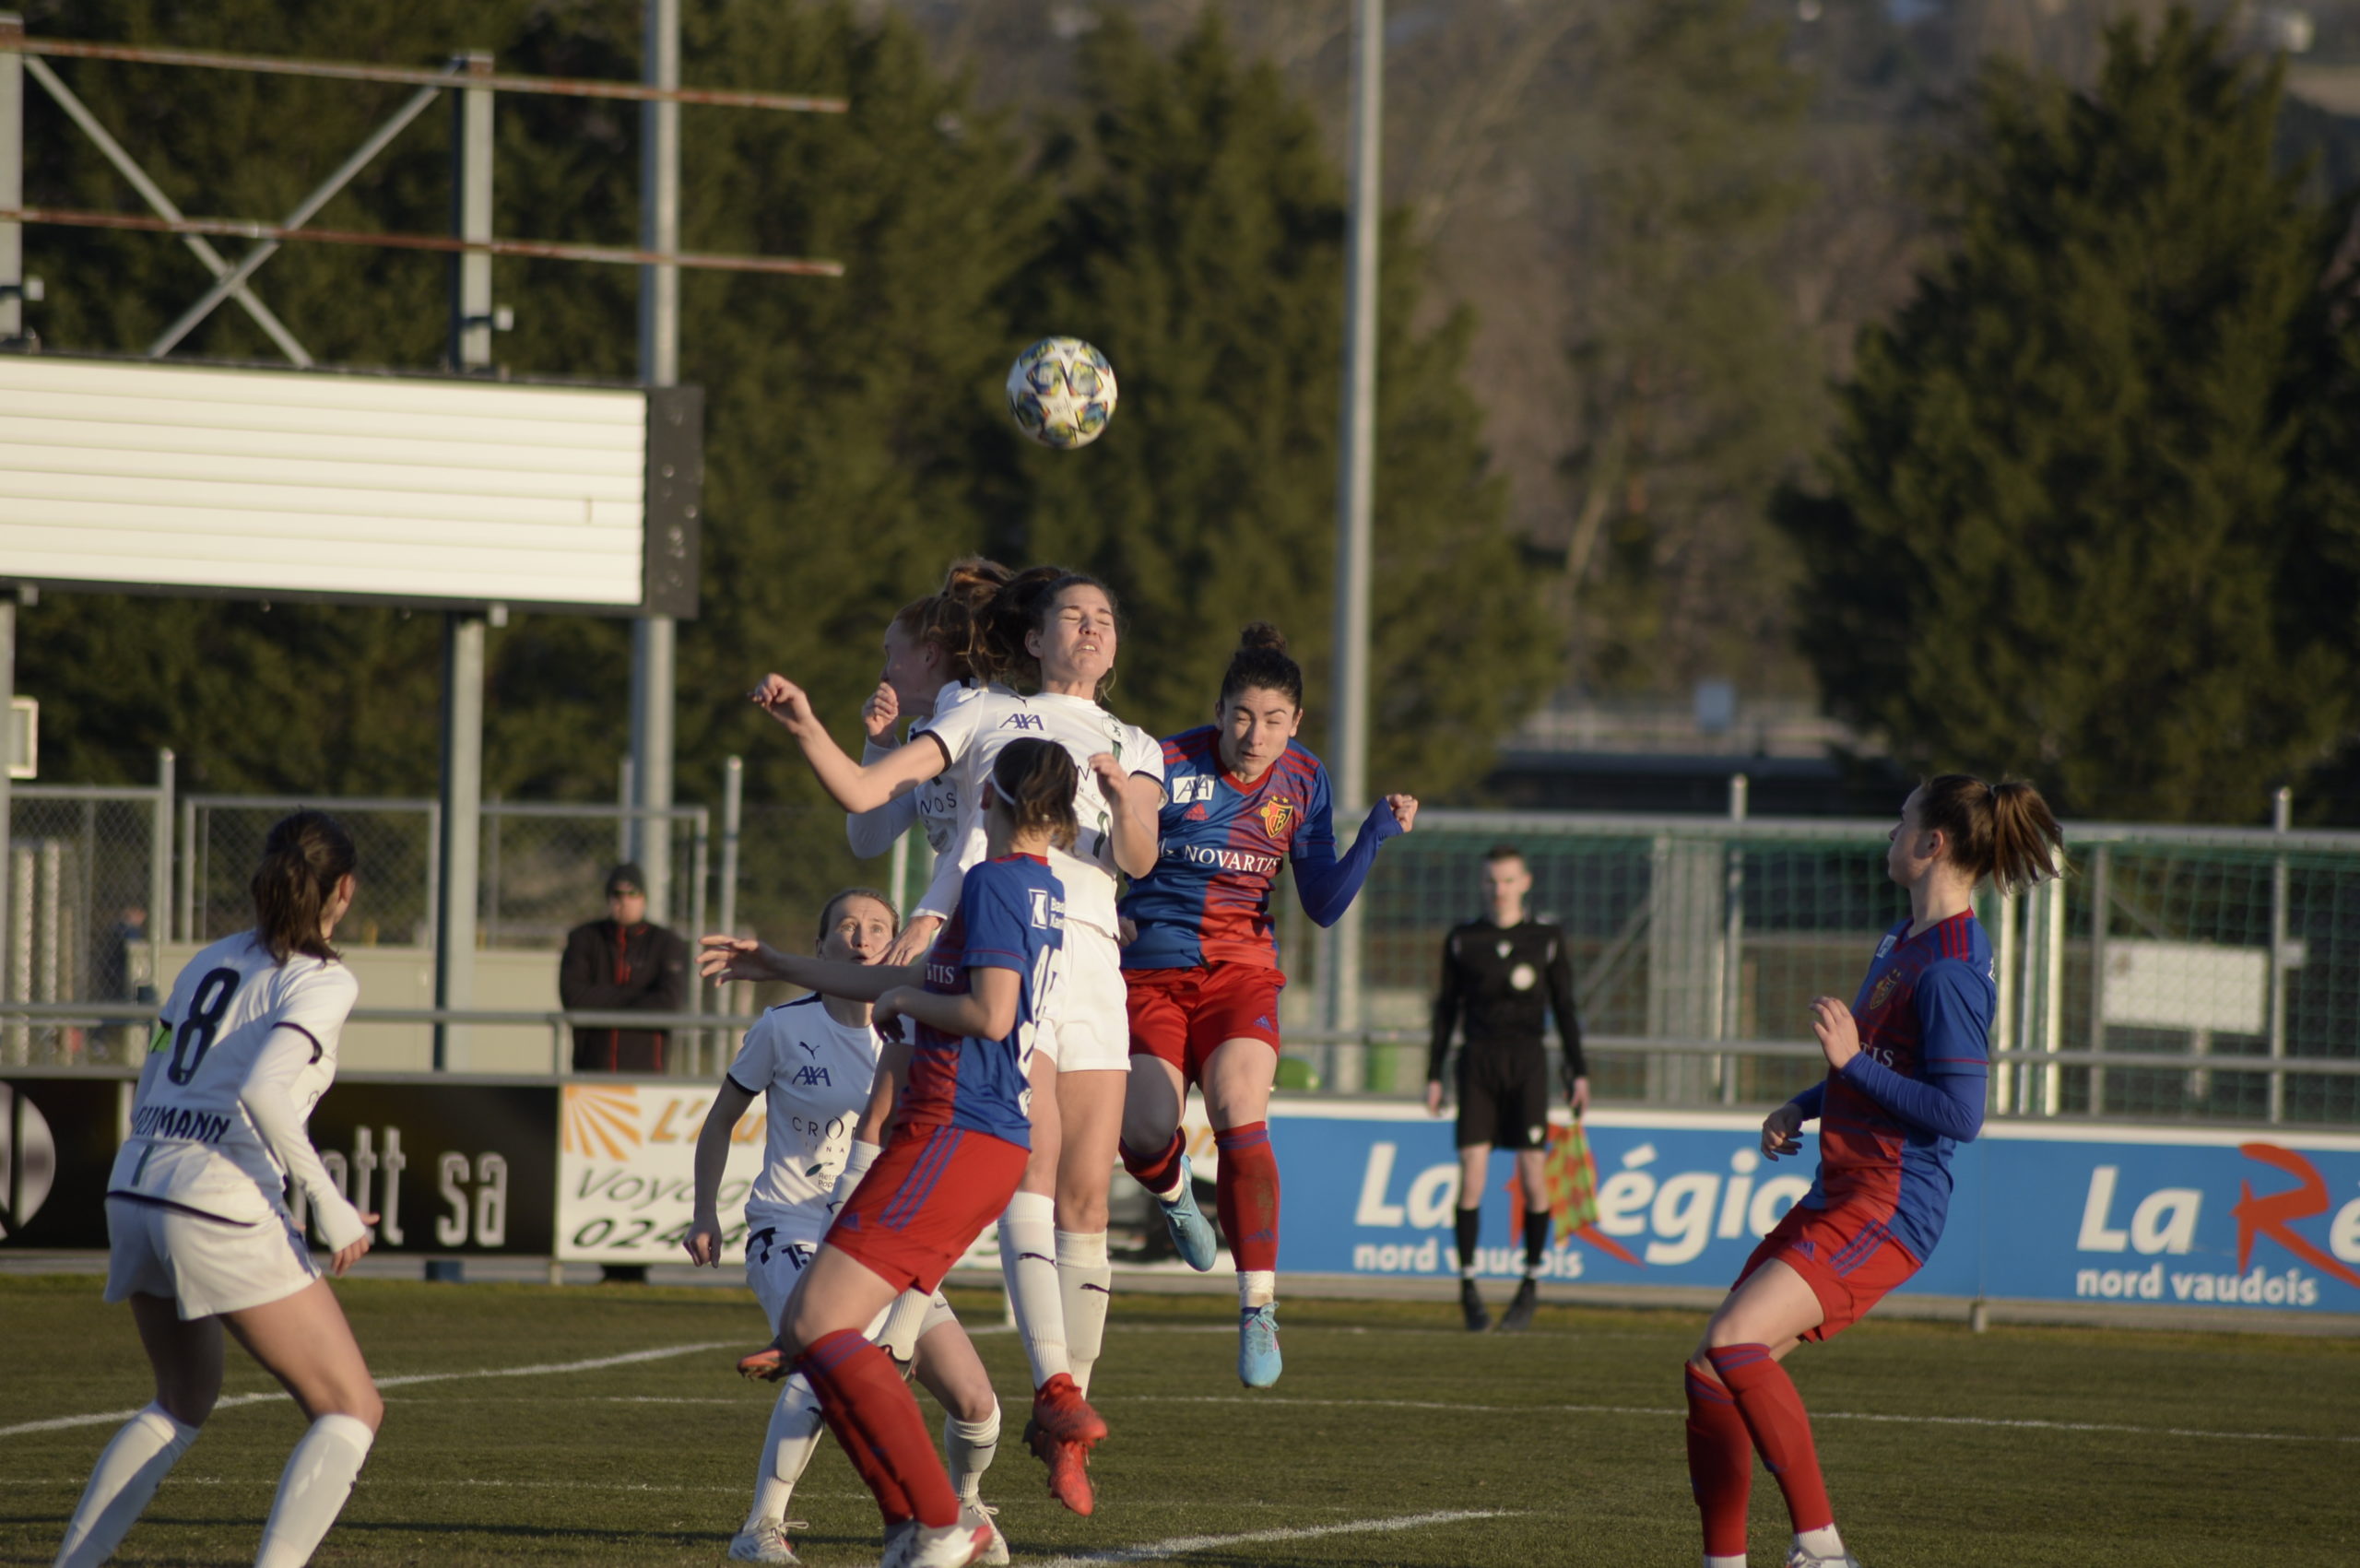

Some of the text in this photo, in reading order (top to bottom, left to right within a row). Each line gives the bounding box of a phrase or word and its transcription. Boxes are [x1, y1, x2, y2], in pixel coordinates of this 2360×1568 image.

[999, 713, 1044, 731] AXA
[1175, 777, 1210, 801] AXA
[1184, 843, 1281, 874] NOVARTIS
[167, 966, 242, 1086] 8
[792, 1065, 832, 1087] AXA
[437, 1150, 508, 1246] sa
[2076, 1164, 2203, 1255] La
[1352, 1236, 1439, 1273] nord
[2075, 1262, 2319, 1306] nord vaudois
